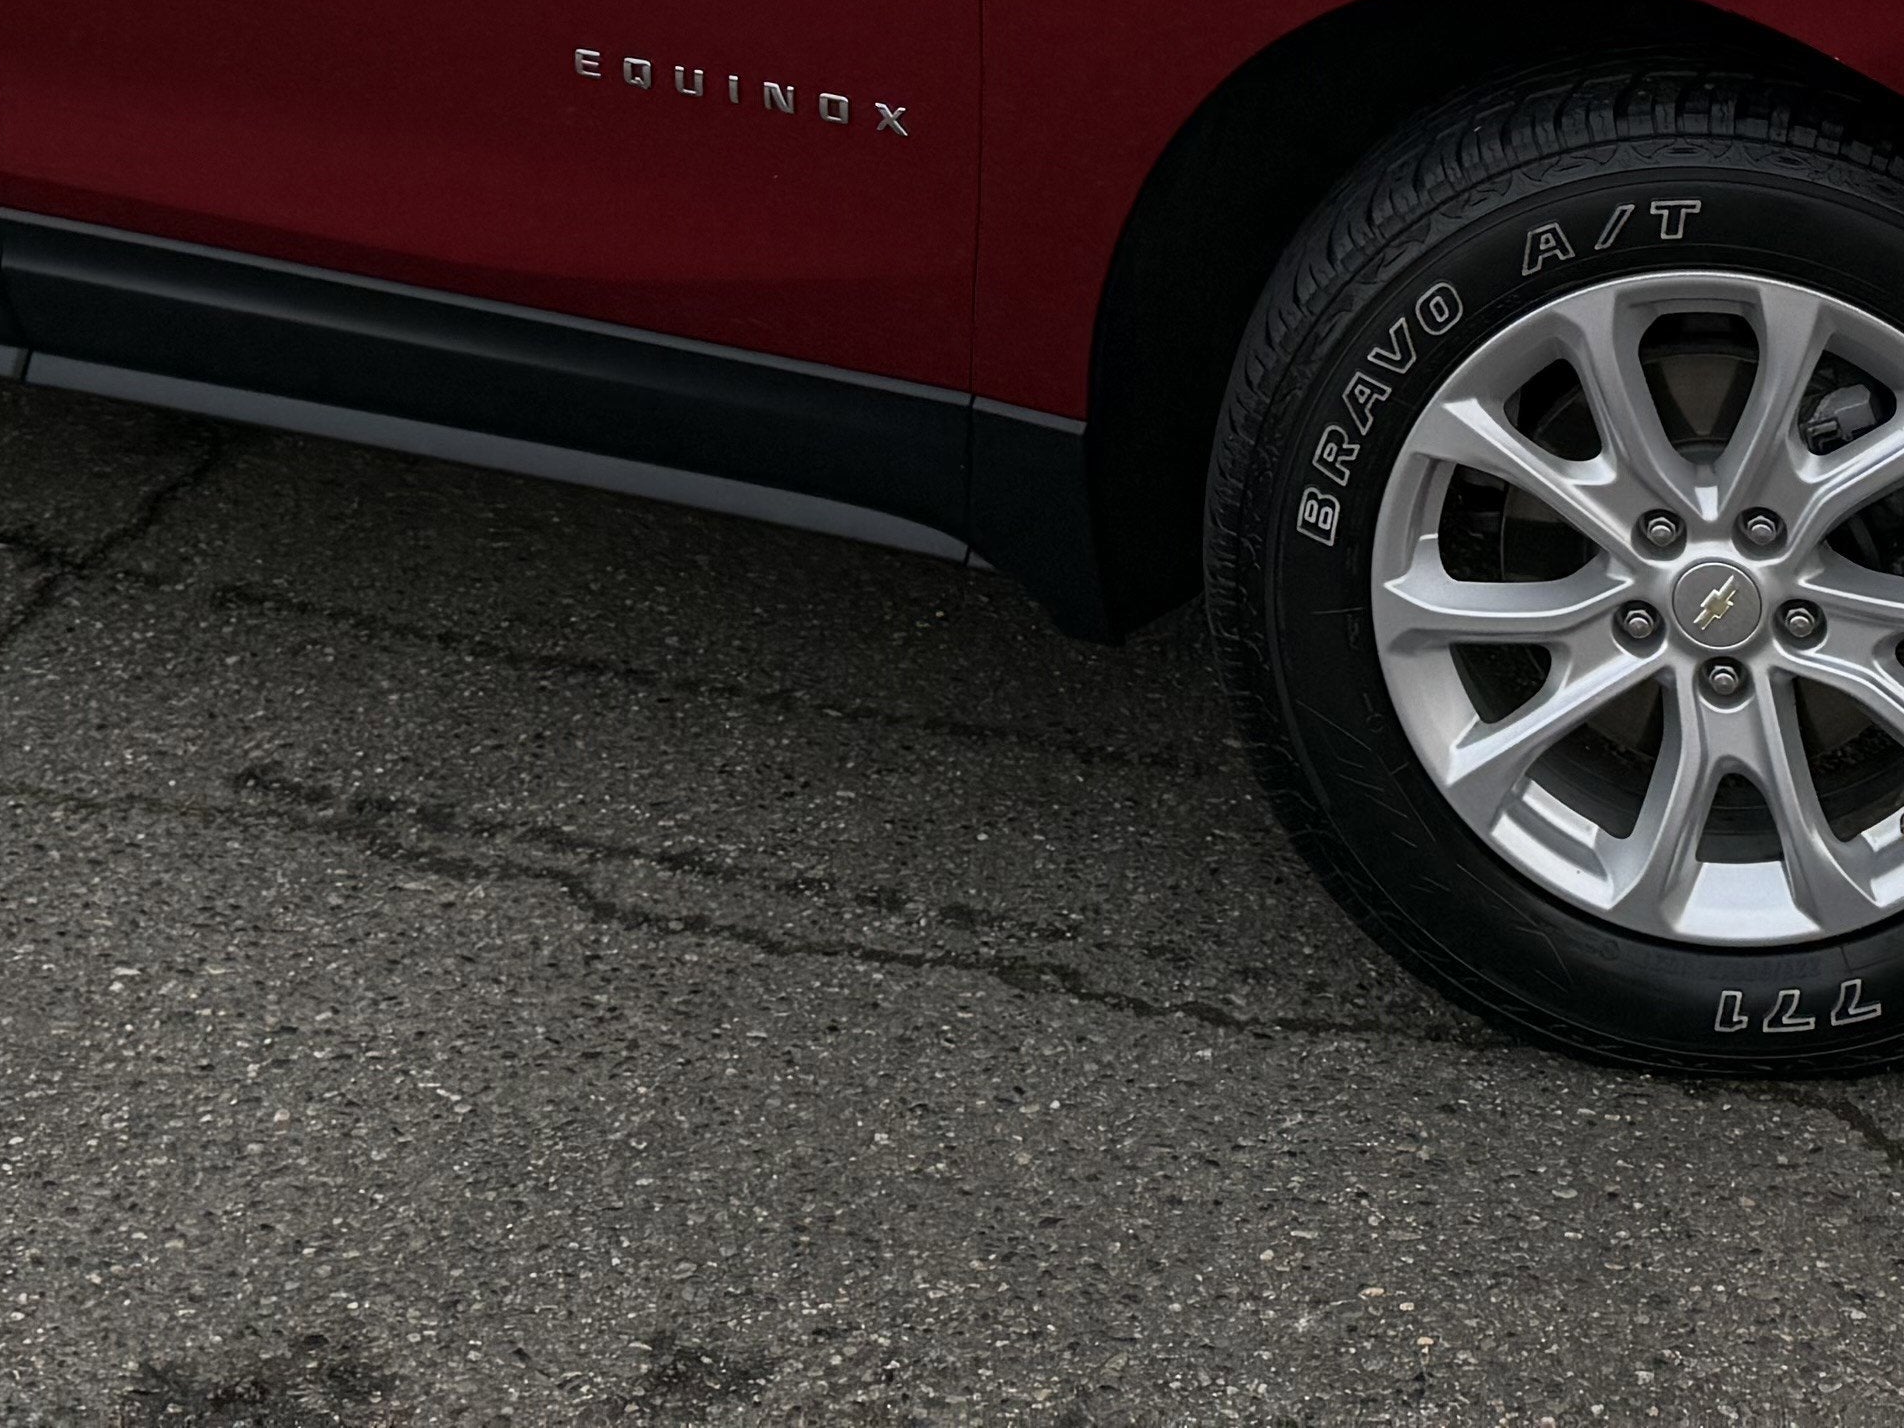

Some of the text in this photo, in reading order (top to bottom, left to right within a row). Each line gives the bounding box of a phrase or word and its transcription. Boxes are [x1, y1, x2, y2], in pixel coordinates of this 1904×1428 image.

[574, 47, 909, 137] EQUINOX
[1296, 197, 1703, 546] BRAVO A/T
[1714, 976, 1884, 1034] 771
